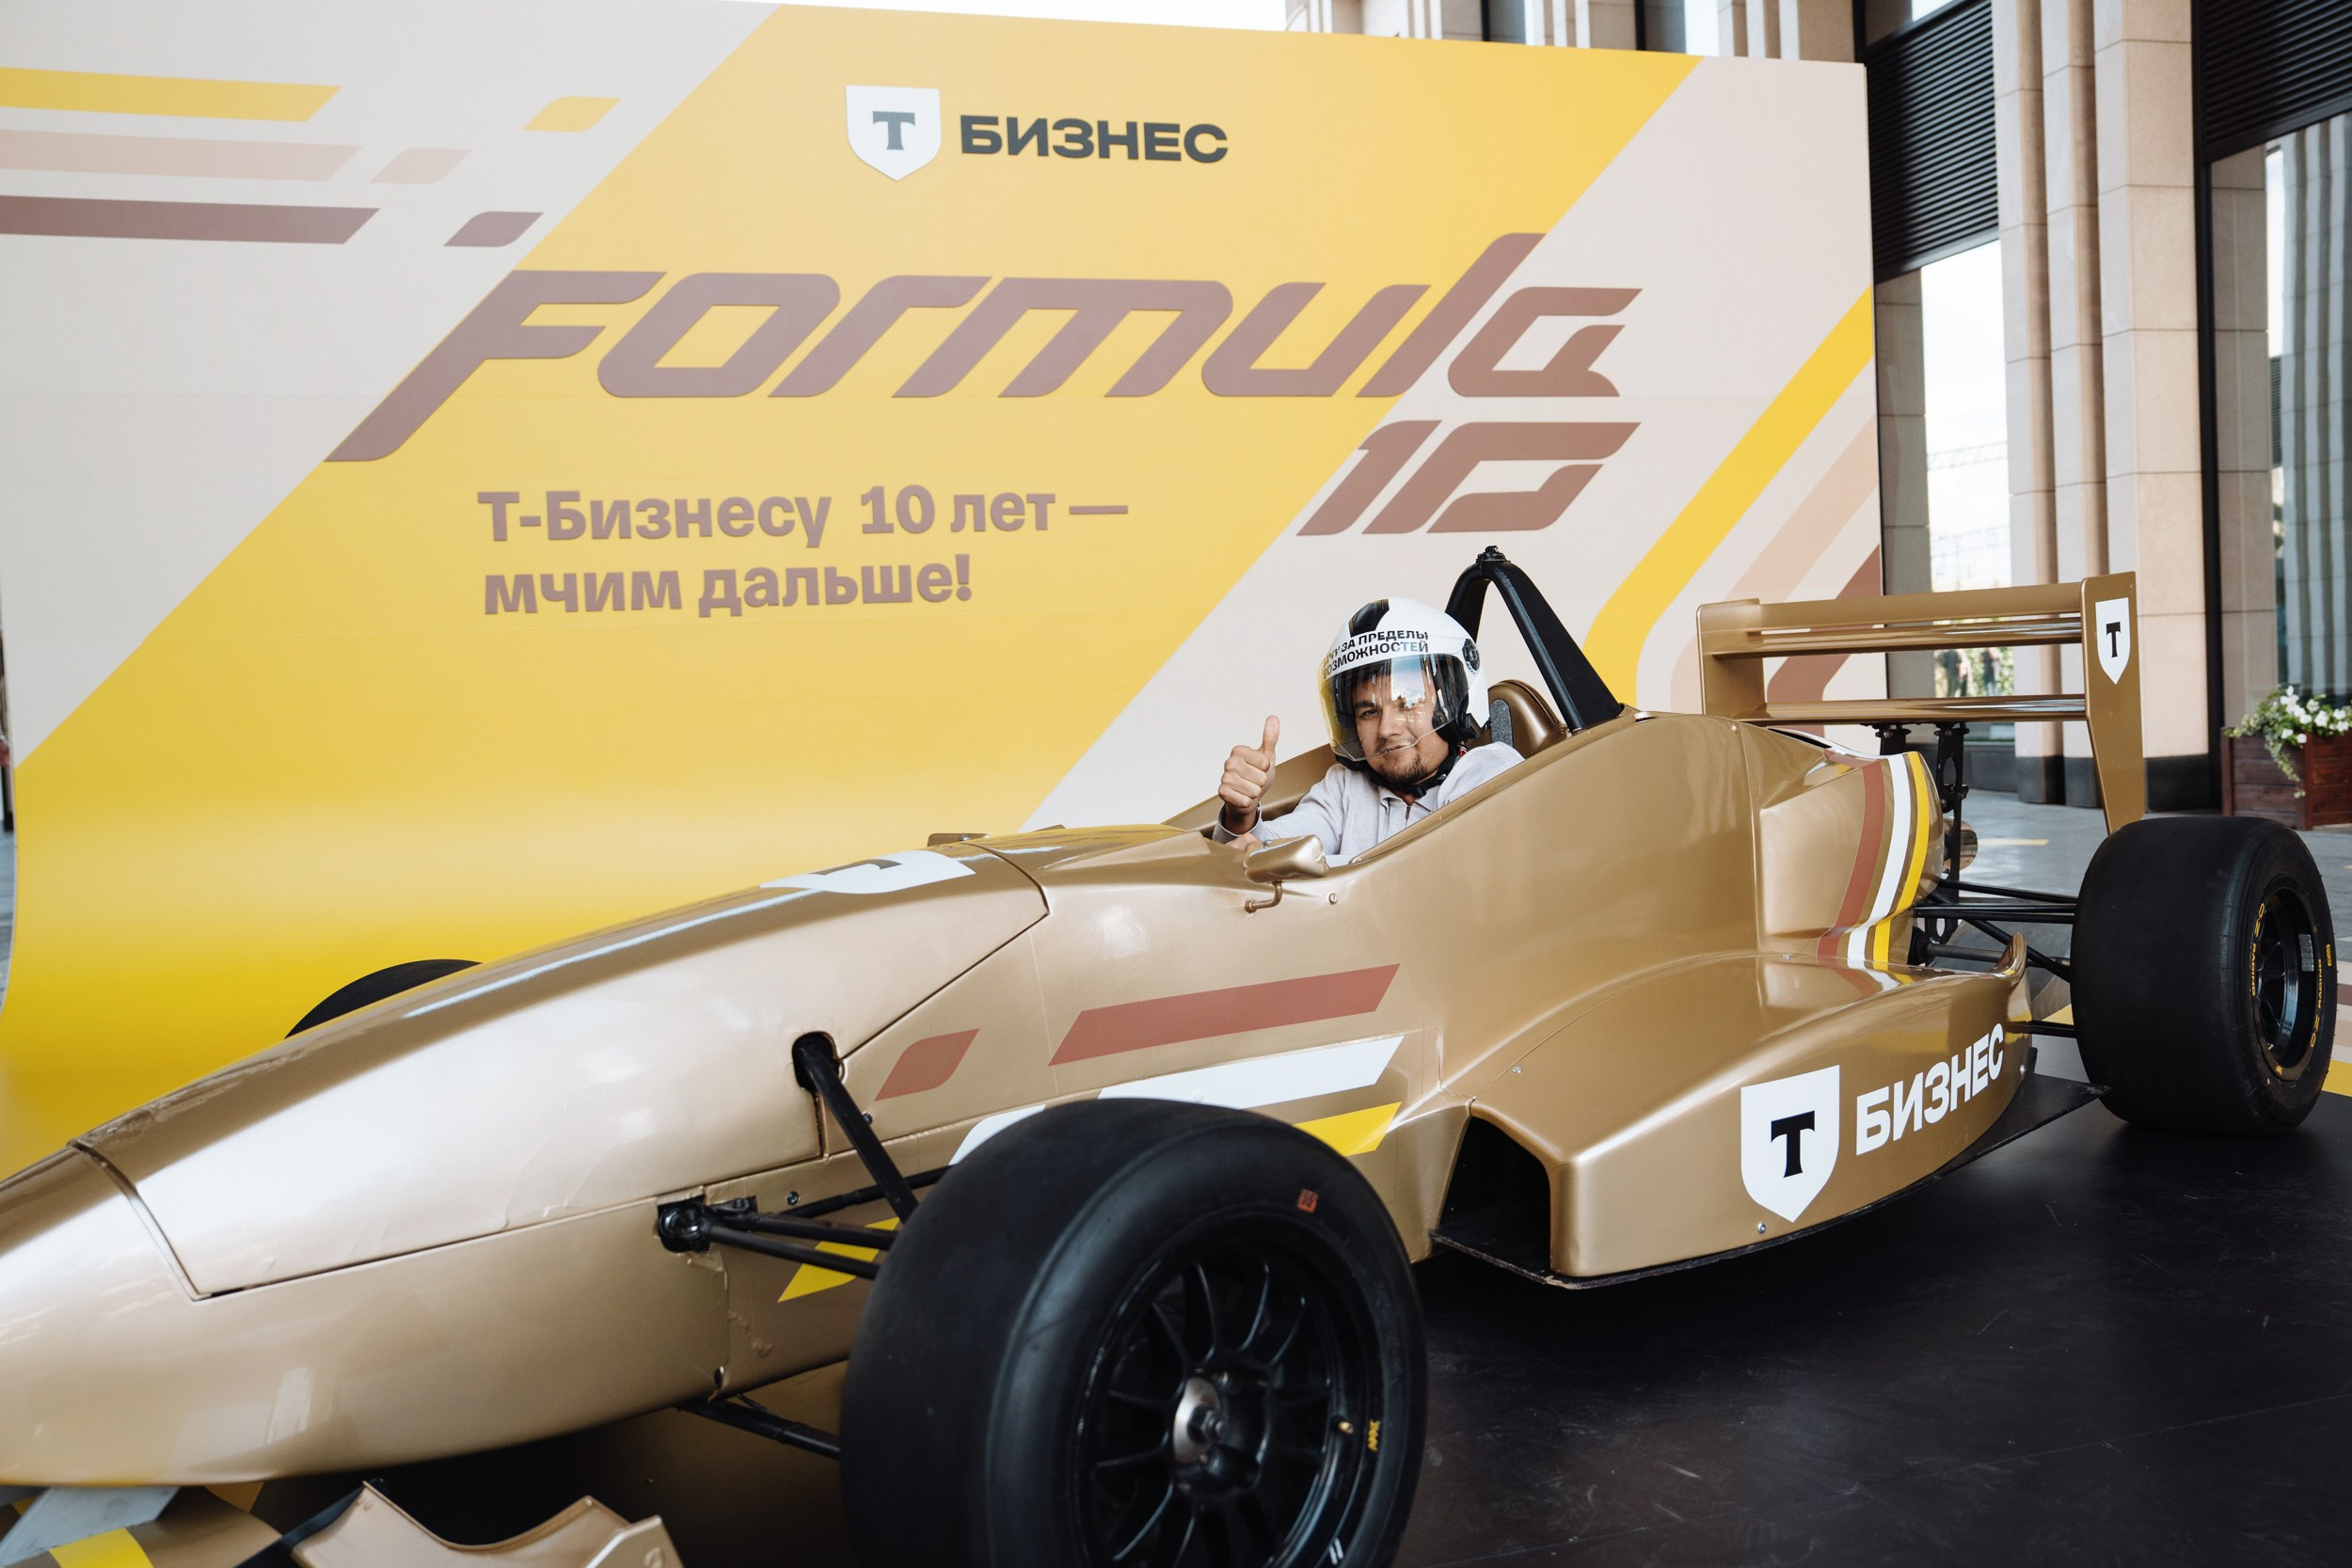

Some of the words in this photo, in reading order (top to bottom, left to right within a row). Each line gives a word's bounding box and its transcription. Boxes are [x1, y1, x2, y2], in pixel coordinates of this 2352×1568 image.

[960, 114, 1230, 164] БИЗНЕС
[323, 232, 1644, 463] Formula
[477, 490, 833, 548] Т-Бизнесу
[860, 484, 936, 534] 10
[950, 492, 1057, 533] лет
[485, 570, 683, 615] мчим
[698, 554, 973, 618] дальше!
[1323, 641, 1429, 680] ВОЗМОЖНОСТЕЙ
[1341, 640, 1356, 653] ЗА
[1359, 630, 1429, 646] ПРЕДЕЛЫ
[1856, 1022, 2004, 1156] БИЗНЕС
